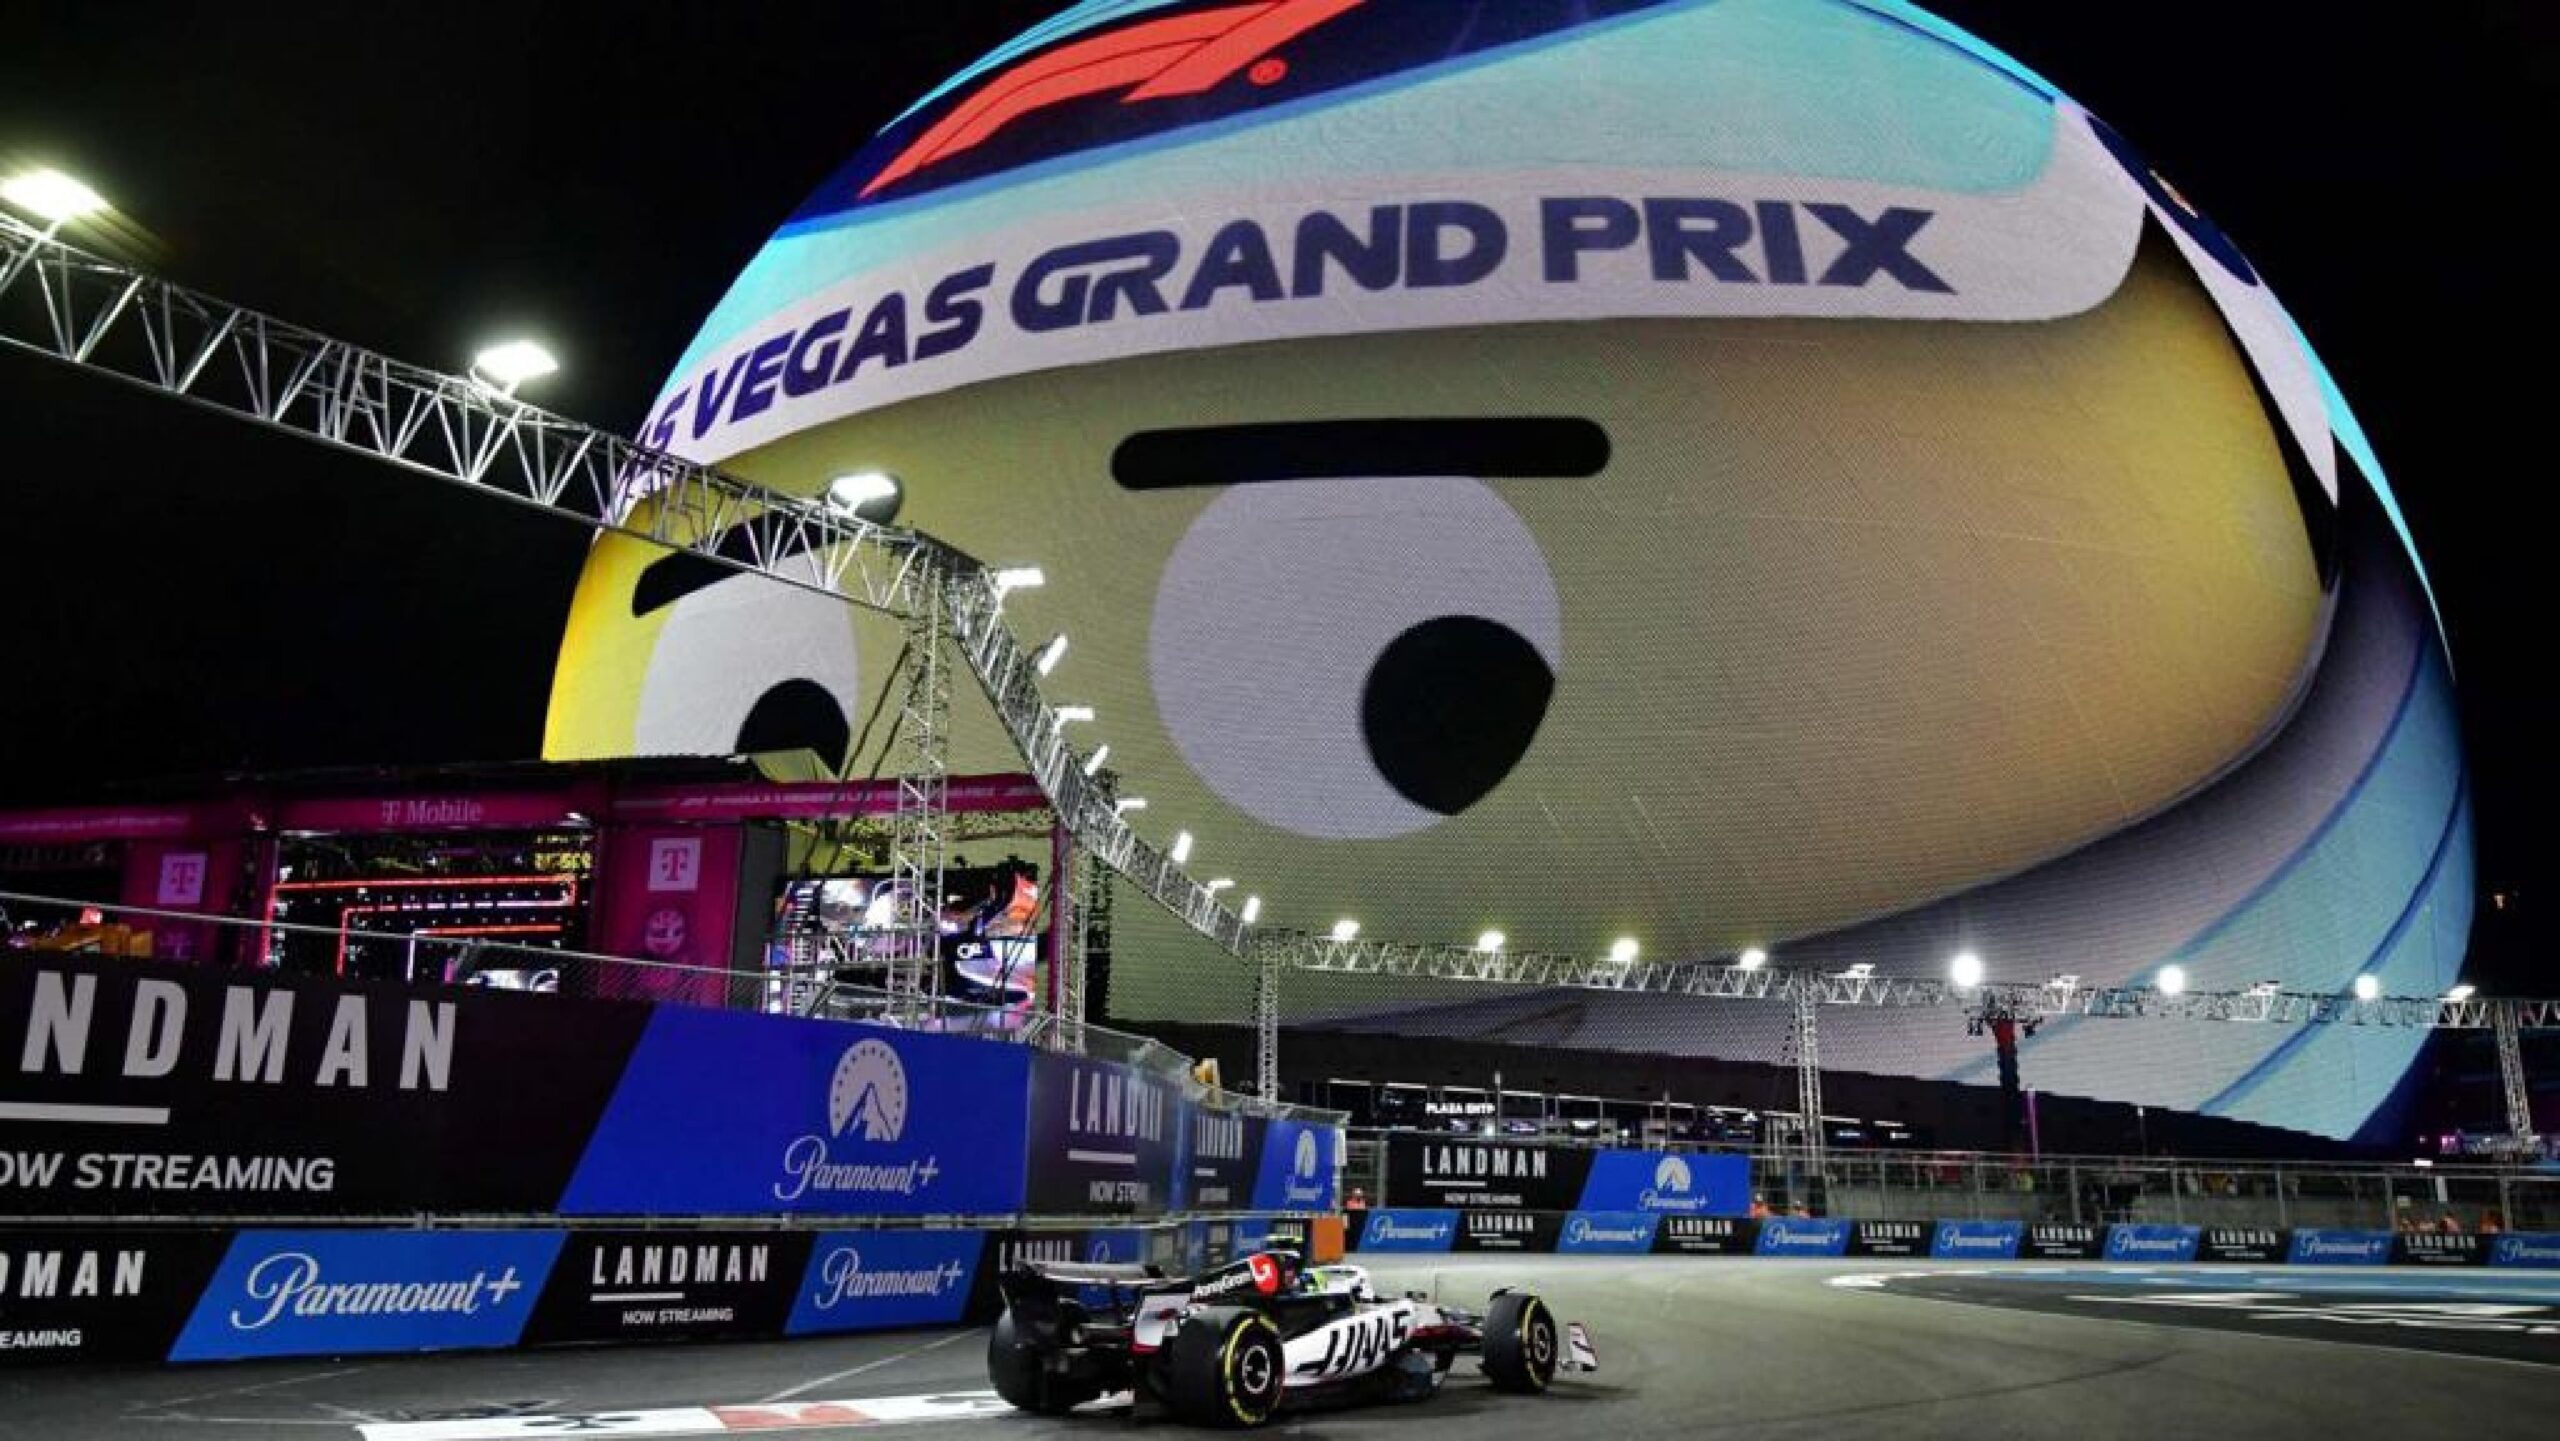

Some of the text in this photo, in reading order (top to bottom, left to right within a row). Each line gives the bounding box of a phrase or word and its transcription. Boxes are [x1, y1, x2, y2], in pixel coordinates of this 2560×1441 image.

[692, 264, 995, 439] VEGAS
[1011, 198, 1508, 332] GRAND
[1540, 196, 1957, 296] PRIX
[408, 800, 482, 823] Mobile
[75, 1152, 334, 1191] STREAMING
[774, 1135, 939, 1201] Paramount+
[1424, 1146, 1546, 1177] LANDMAN
[1469, 1214, 1534, 1231] LANDMAN
[0, 1250, 146, 1298] MAN
[592, 1245, 768, 1285] LANDMAN
[815, 1248, 963, 1309] Paramount+
[231, 1253, 521, 1329] Paramount+
[622, 1308, 733, 1324] NOW STREAMING
